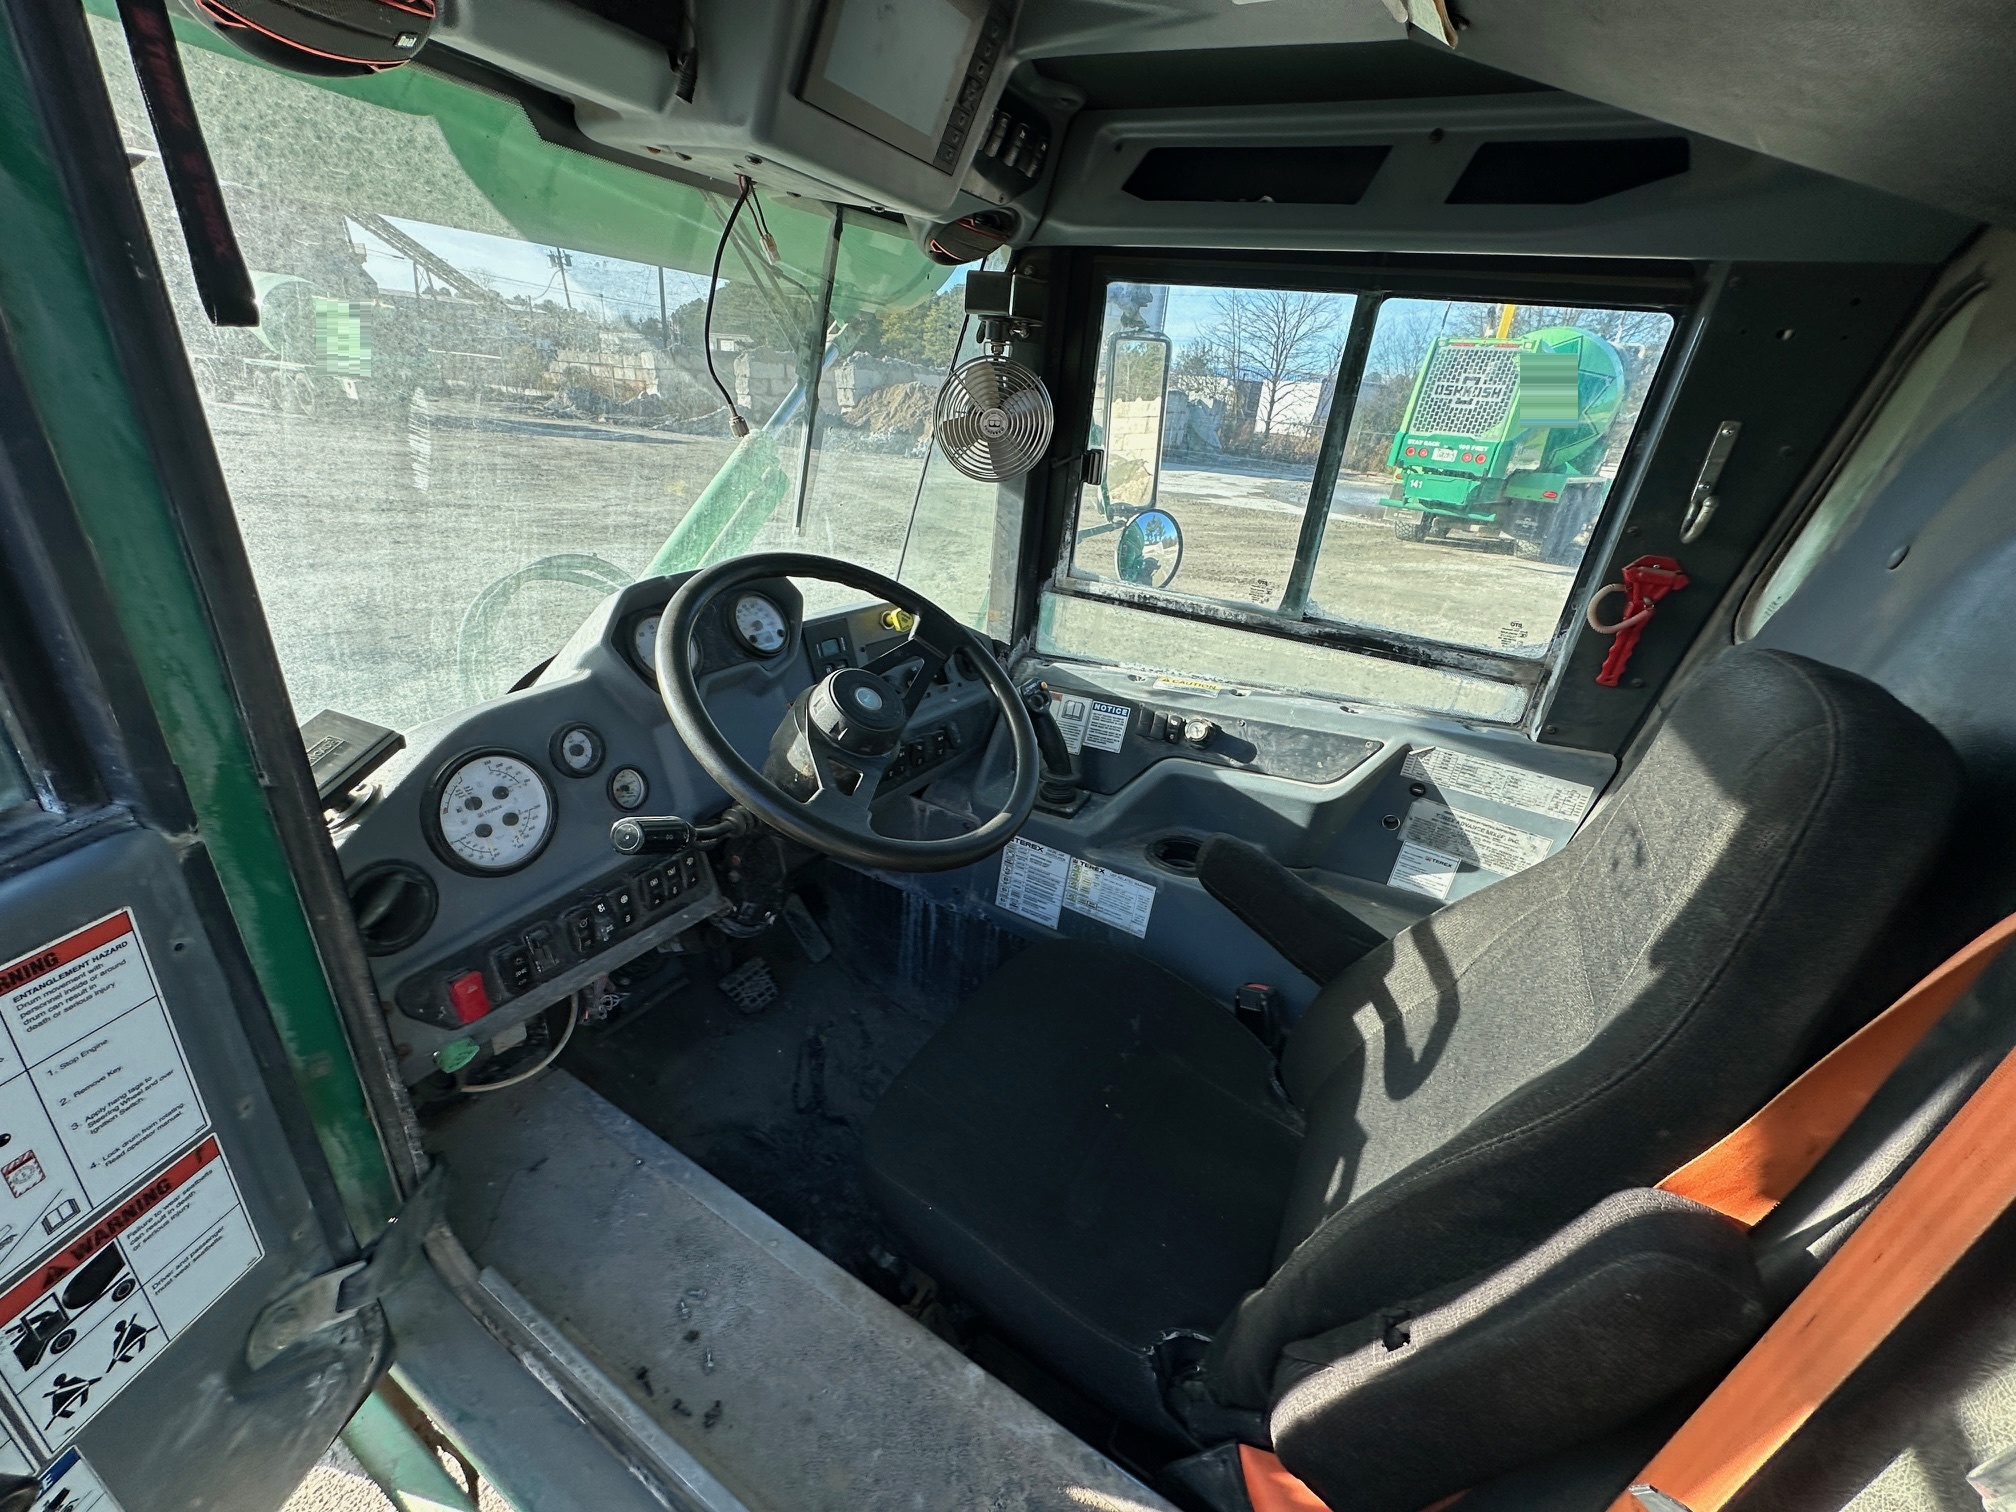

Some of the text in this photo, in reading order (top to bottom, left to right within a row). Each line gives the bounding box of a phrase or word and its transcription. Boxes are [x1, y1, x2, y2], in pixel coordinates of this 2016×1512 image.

[1407, 438, 1424, 446] STAY
[1410, 480, 1423, 489] 141
[1172, 679, 1217, 690] CAUTION
[1094, 703, 1128, 716] NOTICE
[484, 805, 502, 814] TEREX
[1014, 838, 1044, 853] TEREX
[1432, 859, 1452, 868] TEREX
[1080, 861, 1105, 874] TEREX
[0, 951, 59, 991] RNING
[13, 941, 128, 1003] ENTANGLEMENT HAZARD
[16, 963, 104, 1011] Drum movement with
[20, 959, 127, 1019] personnel inside or around
[23, 983, 97, 1026] drum can result in
[27, 982, 116, 1033] death or serious injury
[59, 1056, 79, 1070] Stop
[73, 1075, 106, 1098] Remove
[85, 1106, 106, 1122] Apply
[107, 1093, 127, 1107] hang
[128, 1082, 144, 1095] tags
[145, 1076, 153, 1084] to
[87, 1070, 174, 1129] Steering Wheel and over
[90, 1115, 118, 1135] Ignition
[102, 1146, 121, 1161] Lock
[121, 1133, 141, 1148] drum
[141, 1121, 158, 1134] from
[105, 1151, 126, 1167] Read
[126, 1130, 156, 1153] operator
[70, 1178, 172, 1261] WARNING
[126, 1169, 213, 1240] Failure to wear seatbelts
[129, 1235, 143, 1246] can
[144, 1216, 167, 1235] result
[175, 1191, 196, 1209] death
[142, 1218, 169, 1244] serious
[151, 1226, 225, 1291] Driver and passenger
[154, 1280, 173, 1296] must
[173, 1263, 191, 1279] wear
